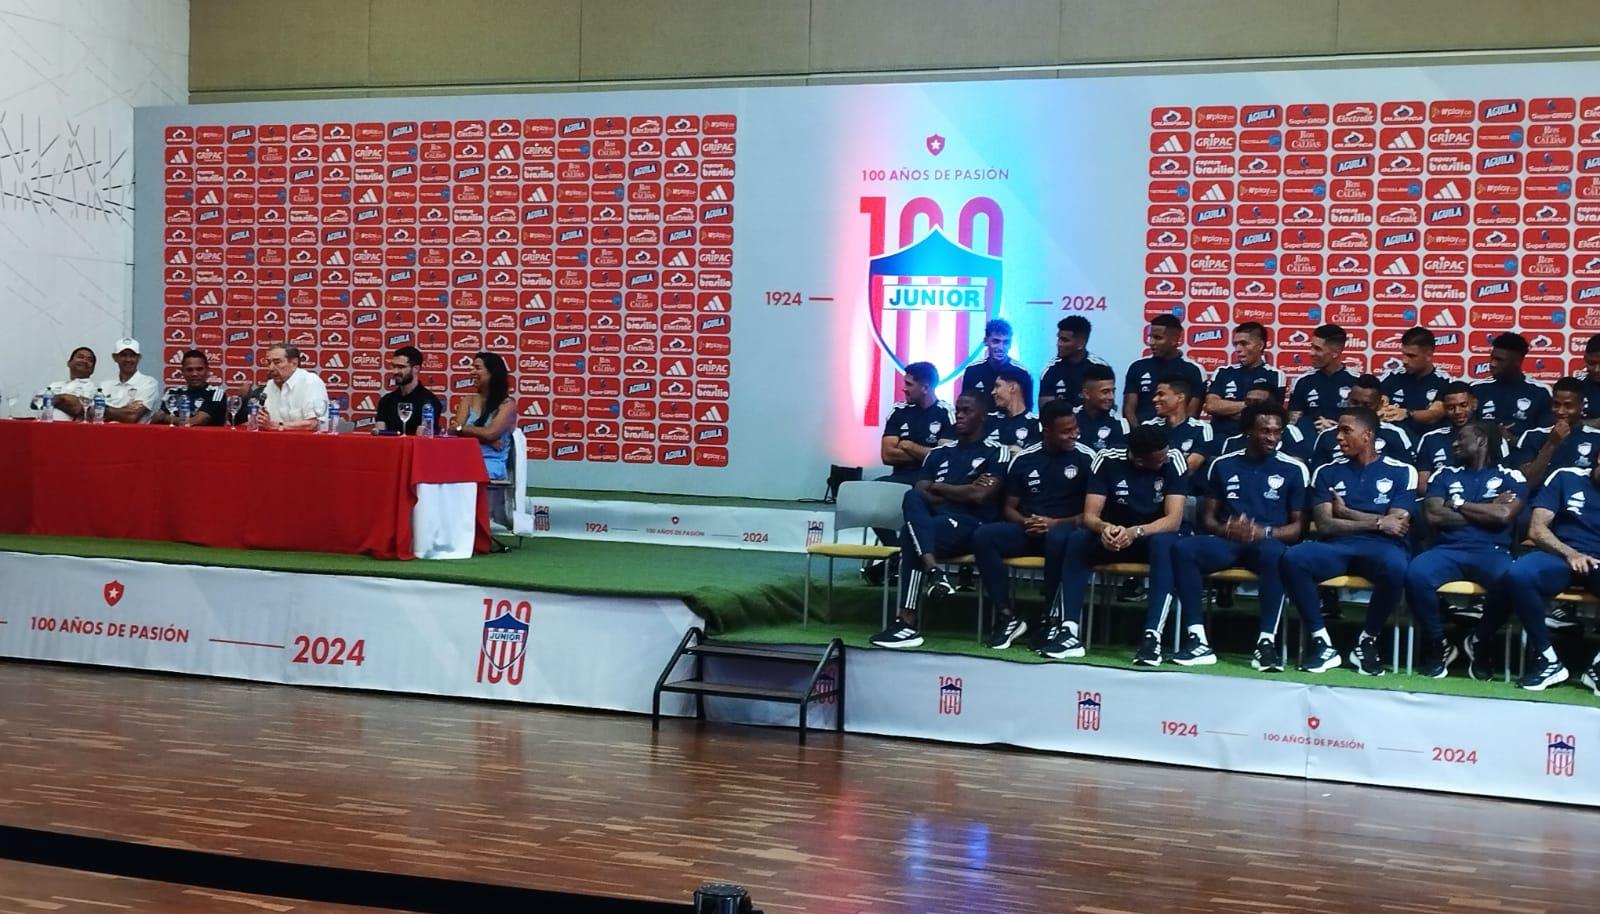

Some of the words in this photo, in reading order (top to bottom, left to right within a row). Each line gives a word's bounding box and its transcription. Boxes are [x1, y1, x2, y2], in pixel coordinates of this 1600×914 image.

[1196, 134, 1232, 146] GRIPAC
[1430, 129, 1471, 142] GRIPAC
[862, 169, 885, 181] 100
[889, 167, 929, 181] AÑOS
[934, 170, 950, 180] DE
[955, 166, 1009, 180] PASIÓN
[1192, 256, 1229, 268] GRIPAC
[1424, 257, 1466, 270] GRIPAC
[765, 292, 802, 306] 1924
[889, 289, 980, 307] JUNIOR
[1062, 296, 1107, 311] 2024
[1434, 335, 1457, 345] GUILA
[585, 522, 608, 533] 1924
[743, 533, 768, 542] 2024
[31, 616, 56, 632] 100
[59, 617, 103, 636] AÑOS
[107, 623, 126, 638] DE
[129, 624, 189, 643] PASIÓN
[477, 599, 531, 686] 100
[292, 636, 365, 666] 2024
[1162, 721, 1198, 737] 1924
[1264, 733, 1280, 742] 100
[1282, 734, 1311, 745] AÑOS
[1314, 738, 1325, 746] DE
[1328, 738, 1364, 750] PASIÓN
[1432, 747, 1478, 764] 2024
